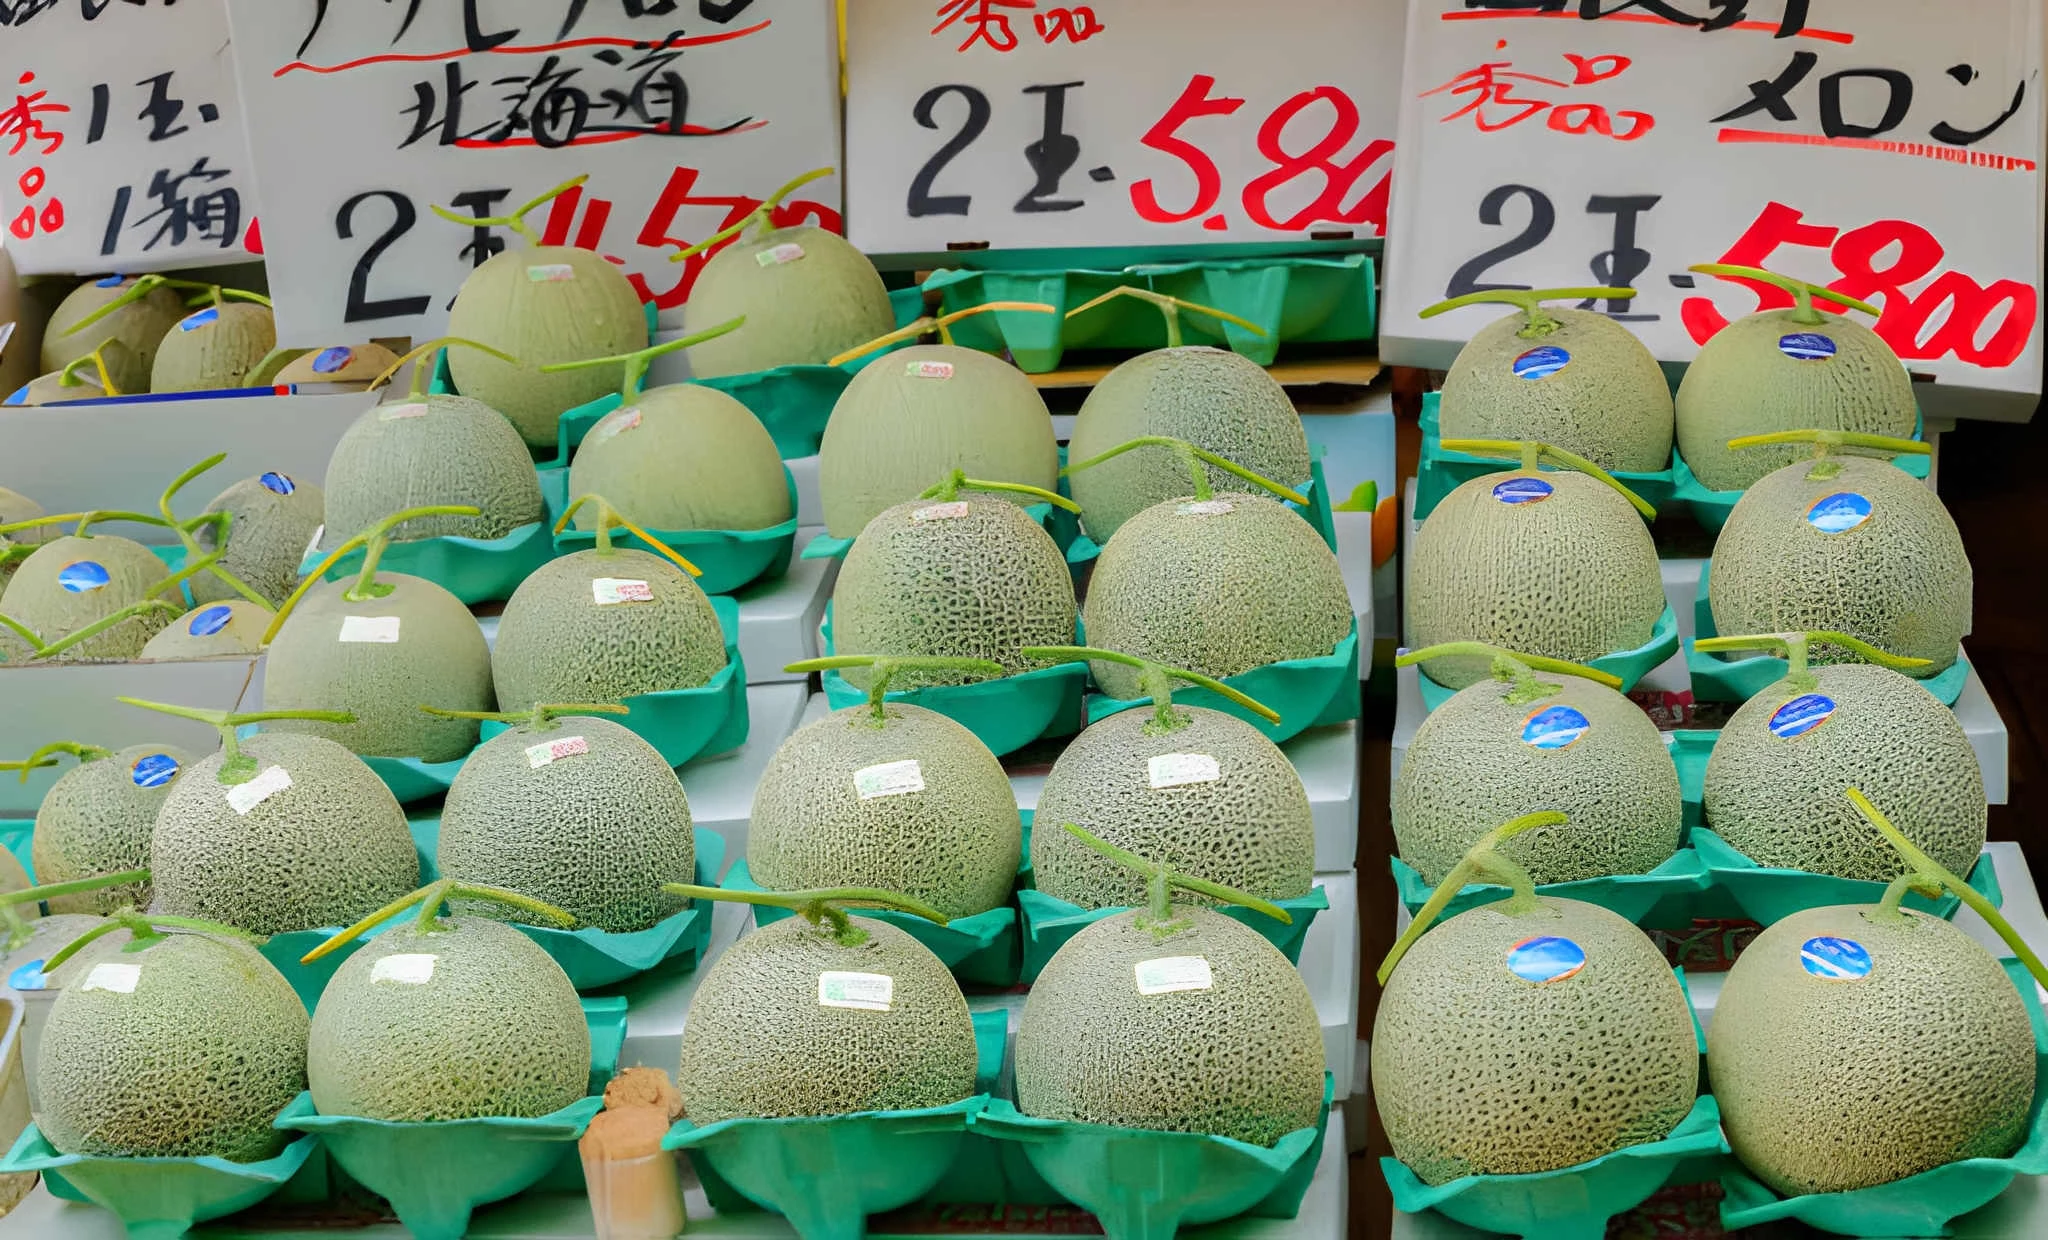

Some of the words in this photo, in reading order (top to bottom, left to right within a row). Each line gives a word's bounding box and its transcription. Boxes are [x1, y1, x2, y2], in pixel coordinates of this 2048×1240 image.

[397, 28, 753, 150] 北海道
[1710, 51, 2028, 146] メロン
